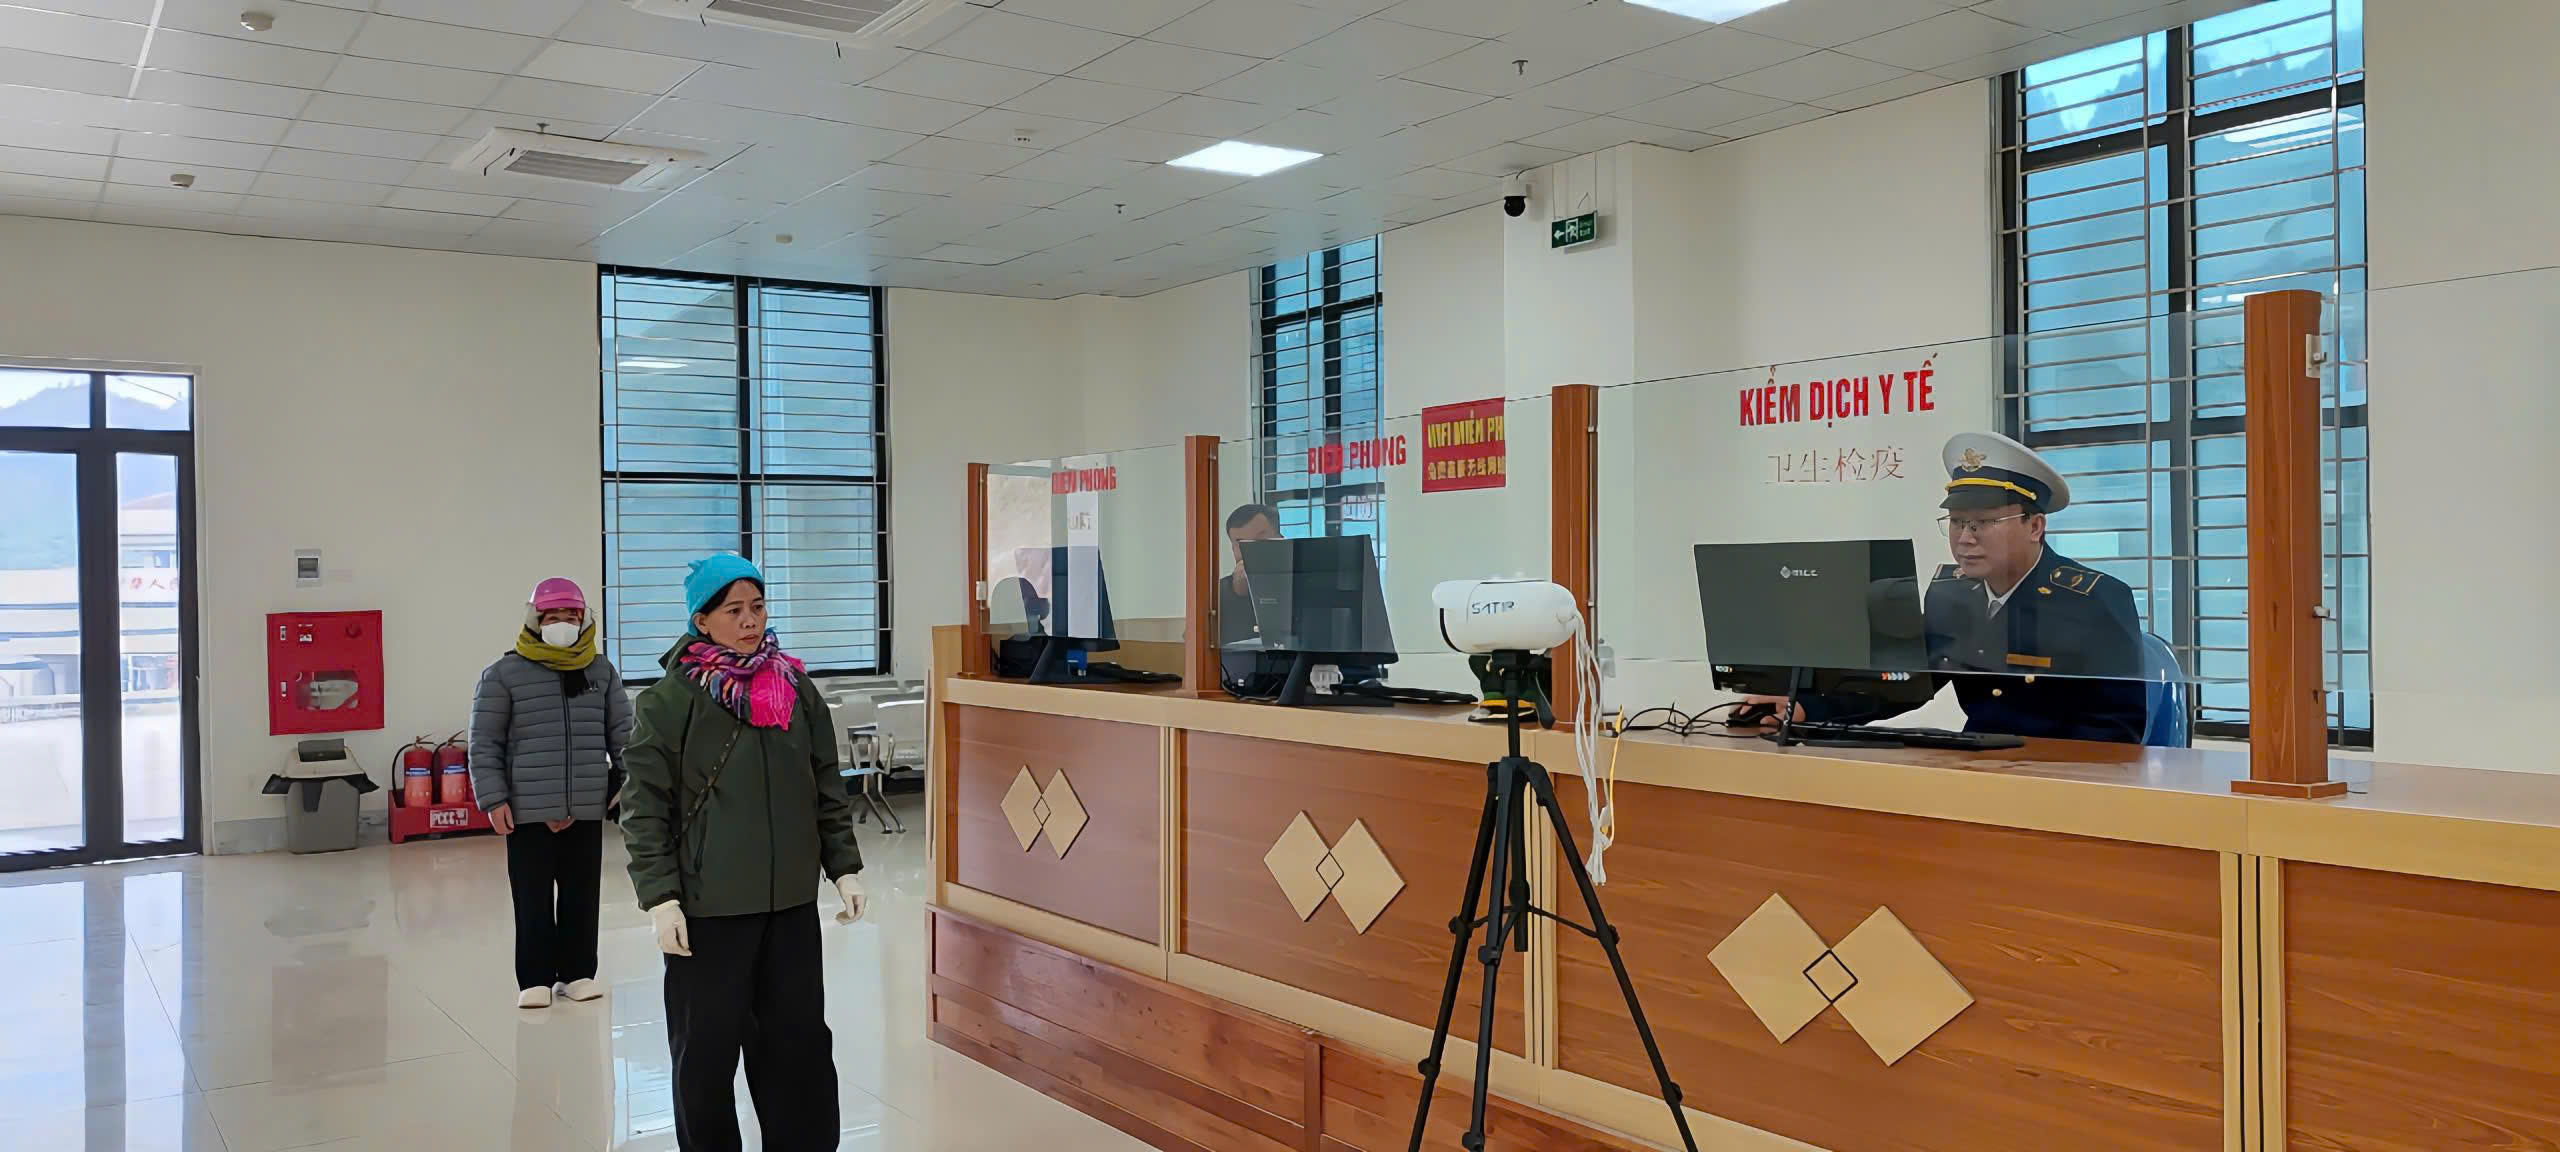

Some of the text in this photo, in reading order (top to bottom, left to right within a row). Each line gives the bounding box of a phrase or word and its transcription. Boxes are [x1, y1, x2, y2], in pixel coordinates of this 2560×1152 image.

[1739, 352, 1938, 428] KIỂM DỊCH Y TẾ
[1487, 416, 1505, 442] PH
[1764, 445, 1905, 484] 卫生检疫
